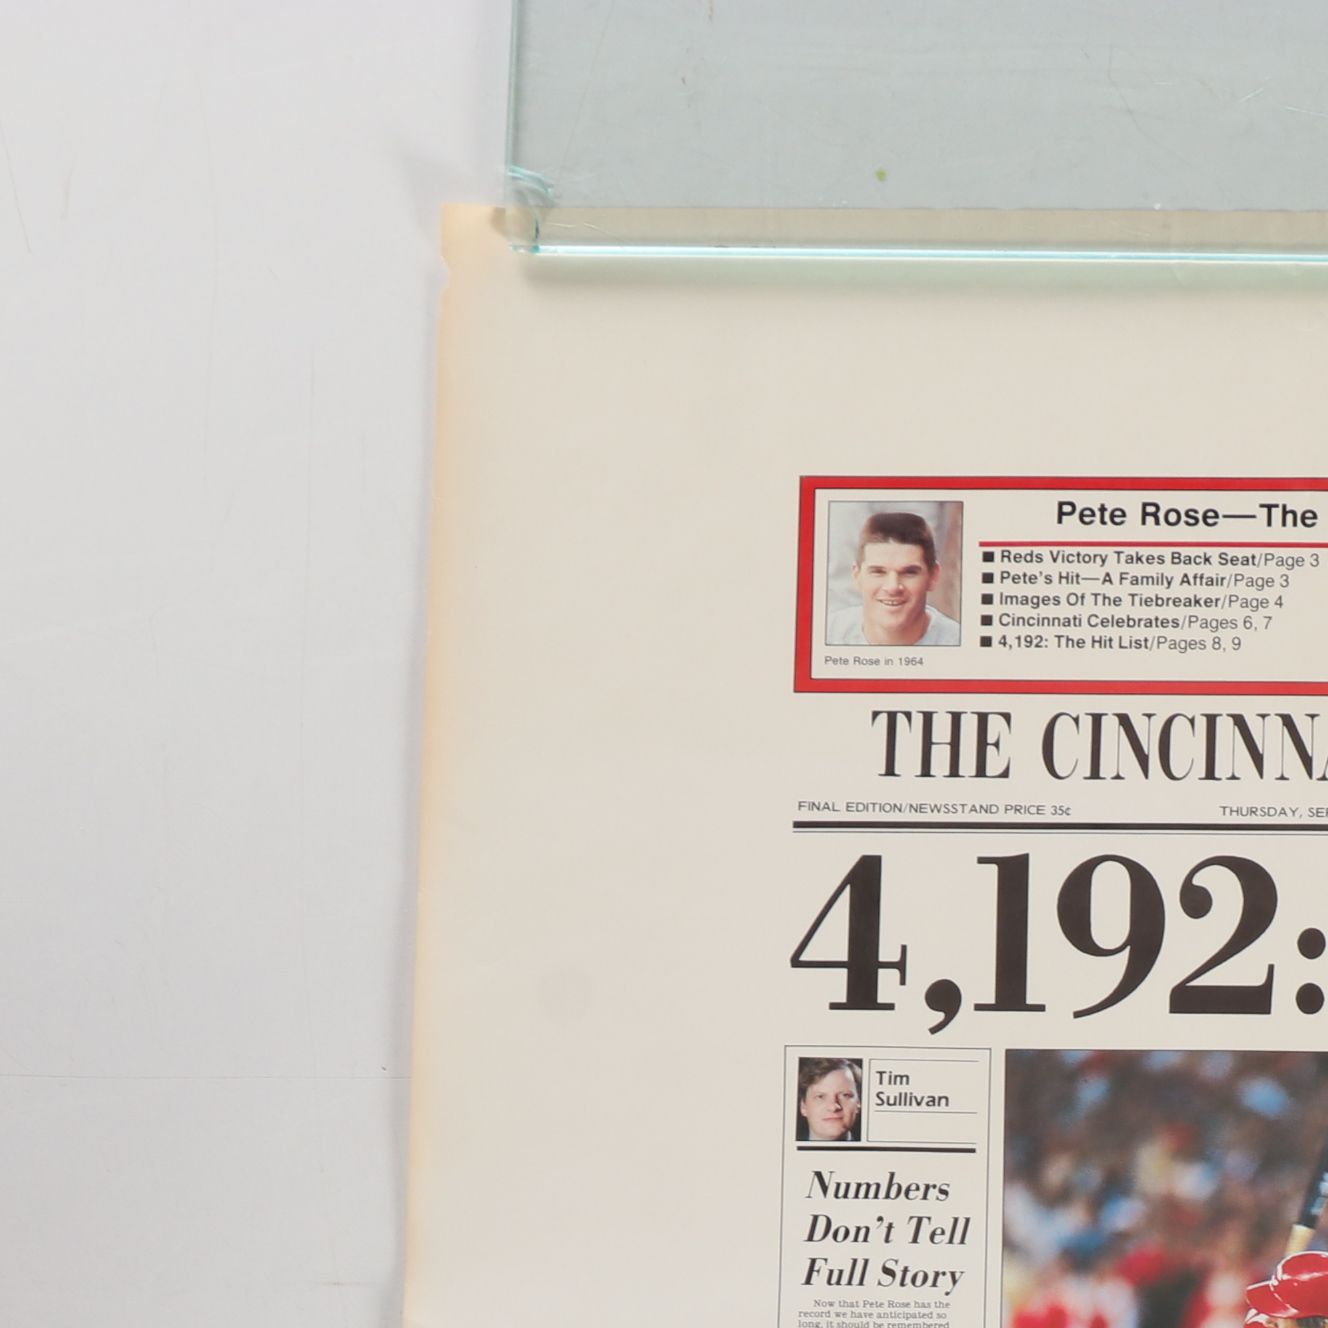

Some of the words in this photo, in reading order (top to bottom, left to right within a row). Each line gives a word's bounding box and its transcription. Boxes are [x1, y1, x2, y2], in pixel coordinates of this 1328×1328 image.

[1056, 500, 1128, 527] Pete
[1140, 501, 1319, 529] Rose—The
[1000, 549, 1044, 564] Reds
[1048, 549, 1109, 568] Victory
[1113, 550, 1166, 566] Takes
[1170, 551, 1213, 566] Back
[1217, 551, 1306, 571] Seat/Page
[1309, 552, 1320, 568] 3
[999, 570, 1054, 585] Pete's
[1057, 570, 1114, 586] Hit—A
[1118, 571, 1175, 590] Family
[1178, 572, 1276, 592] Affair/Page
[1279, 573, 1290, 589] 3
[999, 591, 1062, 610] Images
[1065, 591, 1086, 607] Of
[1090, 592, 1123, 608] The
[1127, 592, 1270, 613] Tiebreaker/Page
[1273, 594, 1284, 609] 4
[998, 612, 1083, 628] Cincinnati
[1086, 613, 1239, 634] Celebrates/Pages
[1242, 614, 1258, 632] 6,
[1262, 615, 1273, 630] 7
[997, 634, 1049, 651] 4,192:
[1053, 634, 1087, 650] The
[1090, 634, 1114, 650] Hit
[1118, 634, 1207, 654] List/Pages
[1211, 635, 1227, 653] 8,
[1231, 635, 1242, 652] 9
[823, 655, 850, 666] Pete
[852, 655, 881, 667] Rose
[883, 656, 895, 667] in
[898, 656, 924, 667] 1964
[871, 709, 1012, 779] THE
[797, 800, 841, 813] FINAL
[845, 801, 1000, 815] EDITION/NEWSSTAND
[1003, 803, 1044, 816] PRICE
[1050, 804, 1072, 817] 35¢
[1218, 805, 1303, 819] THURSDAY,
[789, 852, 1327, 1036] 4,192:
[875, 1070, 910, 1086] Tim
[875, 1090, 950, 1108] Sullivan
[805, 1170, 951, 1202] Numbers
[803, 1213, 895, 1244] Don't
[907, 1215, 971, 1246] Tell
[801, 1257, 870, 1287] Full
[876, 1258, 965, 1297] Story
